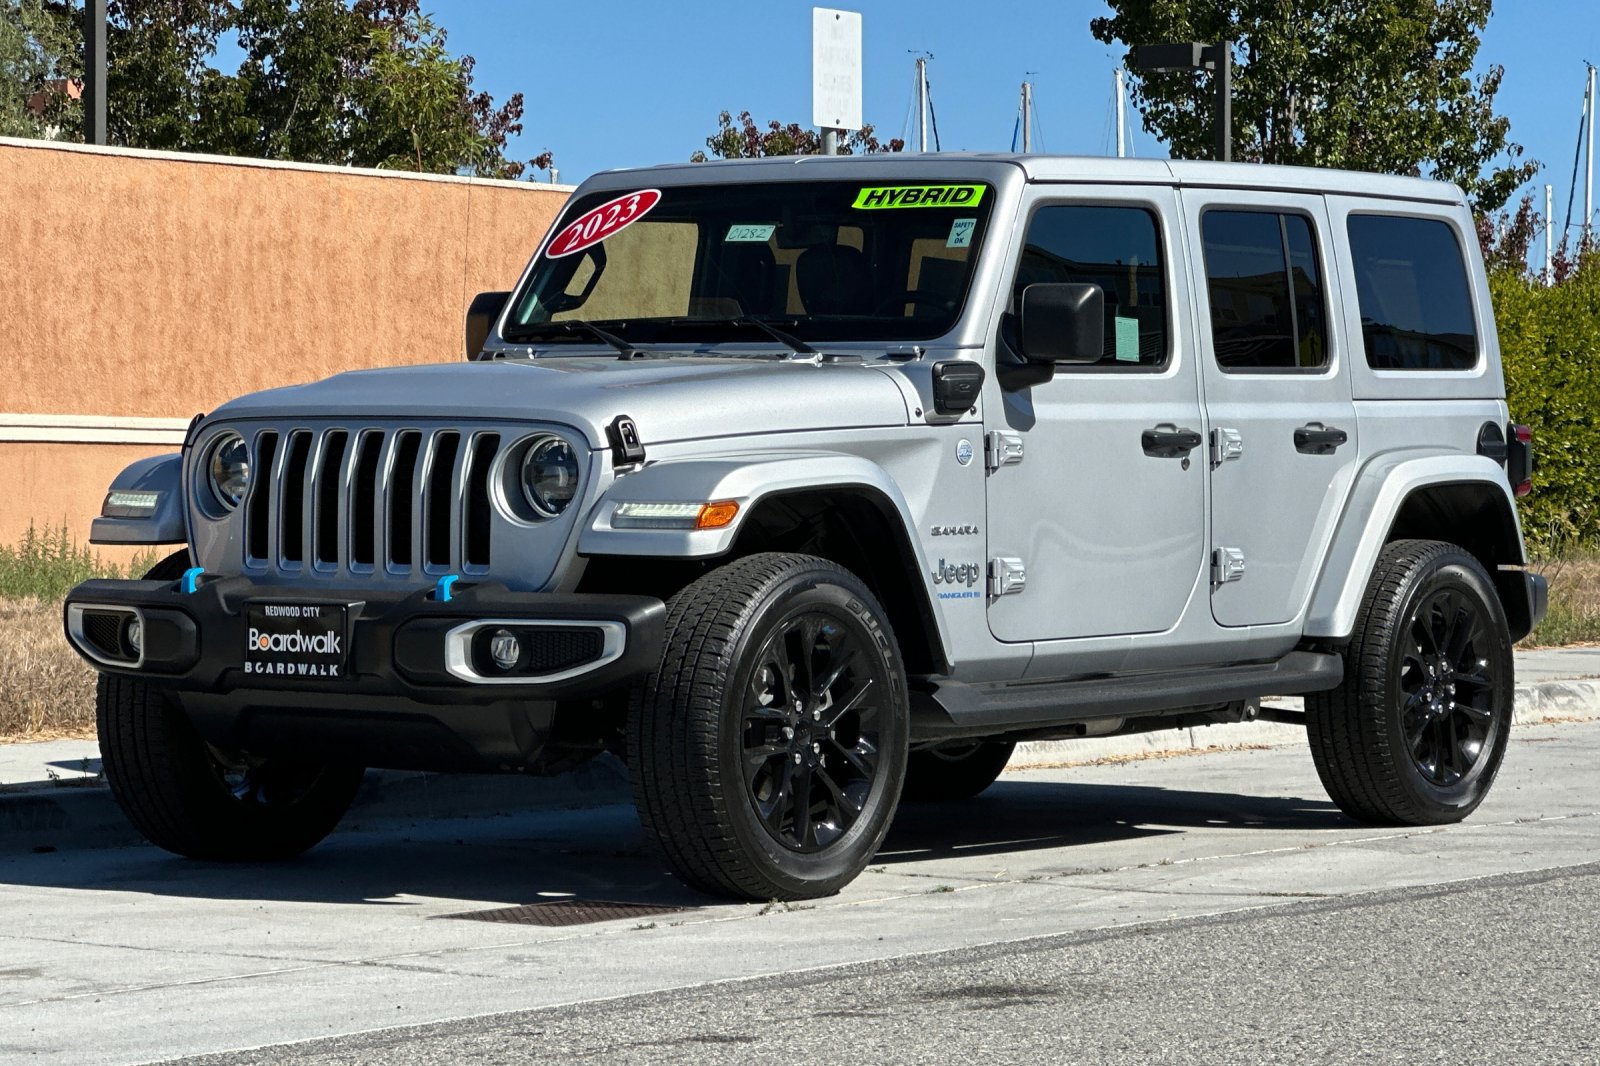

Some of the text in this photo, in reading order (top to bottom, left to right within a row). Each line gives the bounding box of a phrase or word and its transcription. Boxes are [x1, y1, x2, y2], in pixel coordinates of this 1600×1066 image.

[862, 187, 976, 206] HYBRID
[562, 195, 641, 252] 2023
[931, 525, 979, 536] SAHARA
[931, 558, 979, 588] Jeep
[264, 605, 320, 618] REDWOOD CITY
[248, 627, 341, 654] Boardwalk
[244, 661, 339, 677] BOARDWALK
